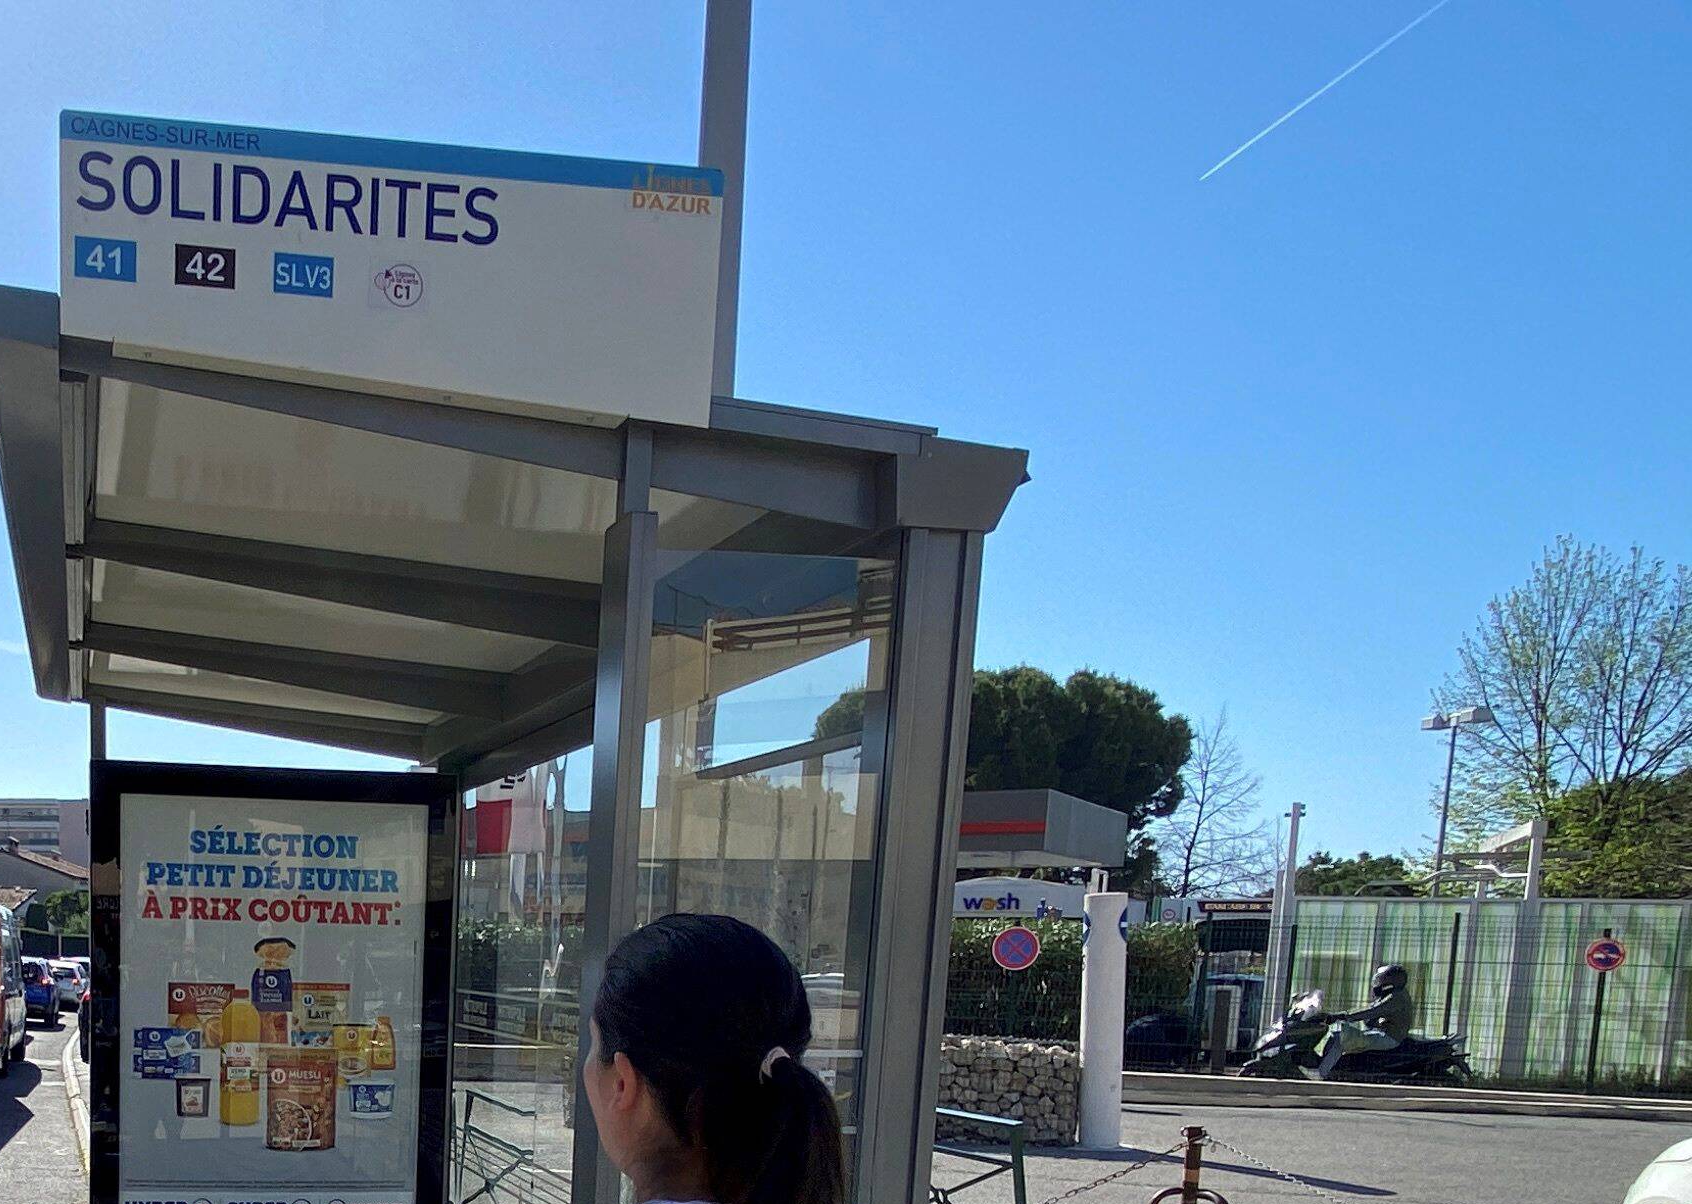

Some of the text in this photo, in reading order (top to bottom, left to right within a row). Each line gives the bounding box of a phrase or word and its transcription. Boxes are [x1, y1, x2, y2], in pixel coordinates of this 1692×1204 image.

[70, 116, 261, 151] CAGNES-SUR-MER
[76, 150, 500, 246] SOLIDARITES
[85, 243, 122, 276] 41
[185, 251, 226, 282] 42
[274, 261, 331, 290] SLV3
[394, 284, 411, 300] C1
[189, 825, 360, 860] SÉLECTION
[146, 860, 400, 893] PETIT DÉJEUNER
[141, 889, 164, 920] À
[169, 896, 242, 921] PRIX
[963, 892, 1020, 911] wash
